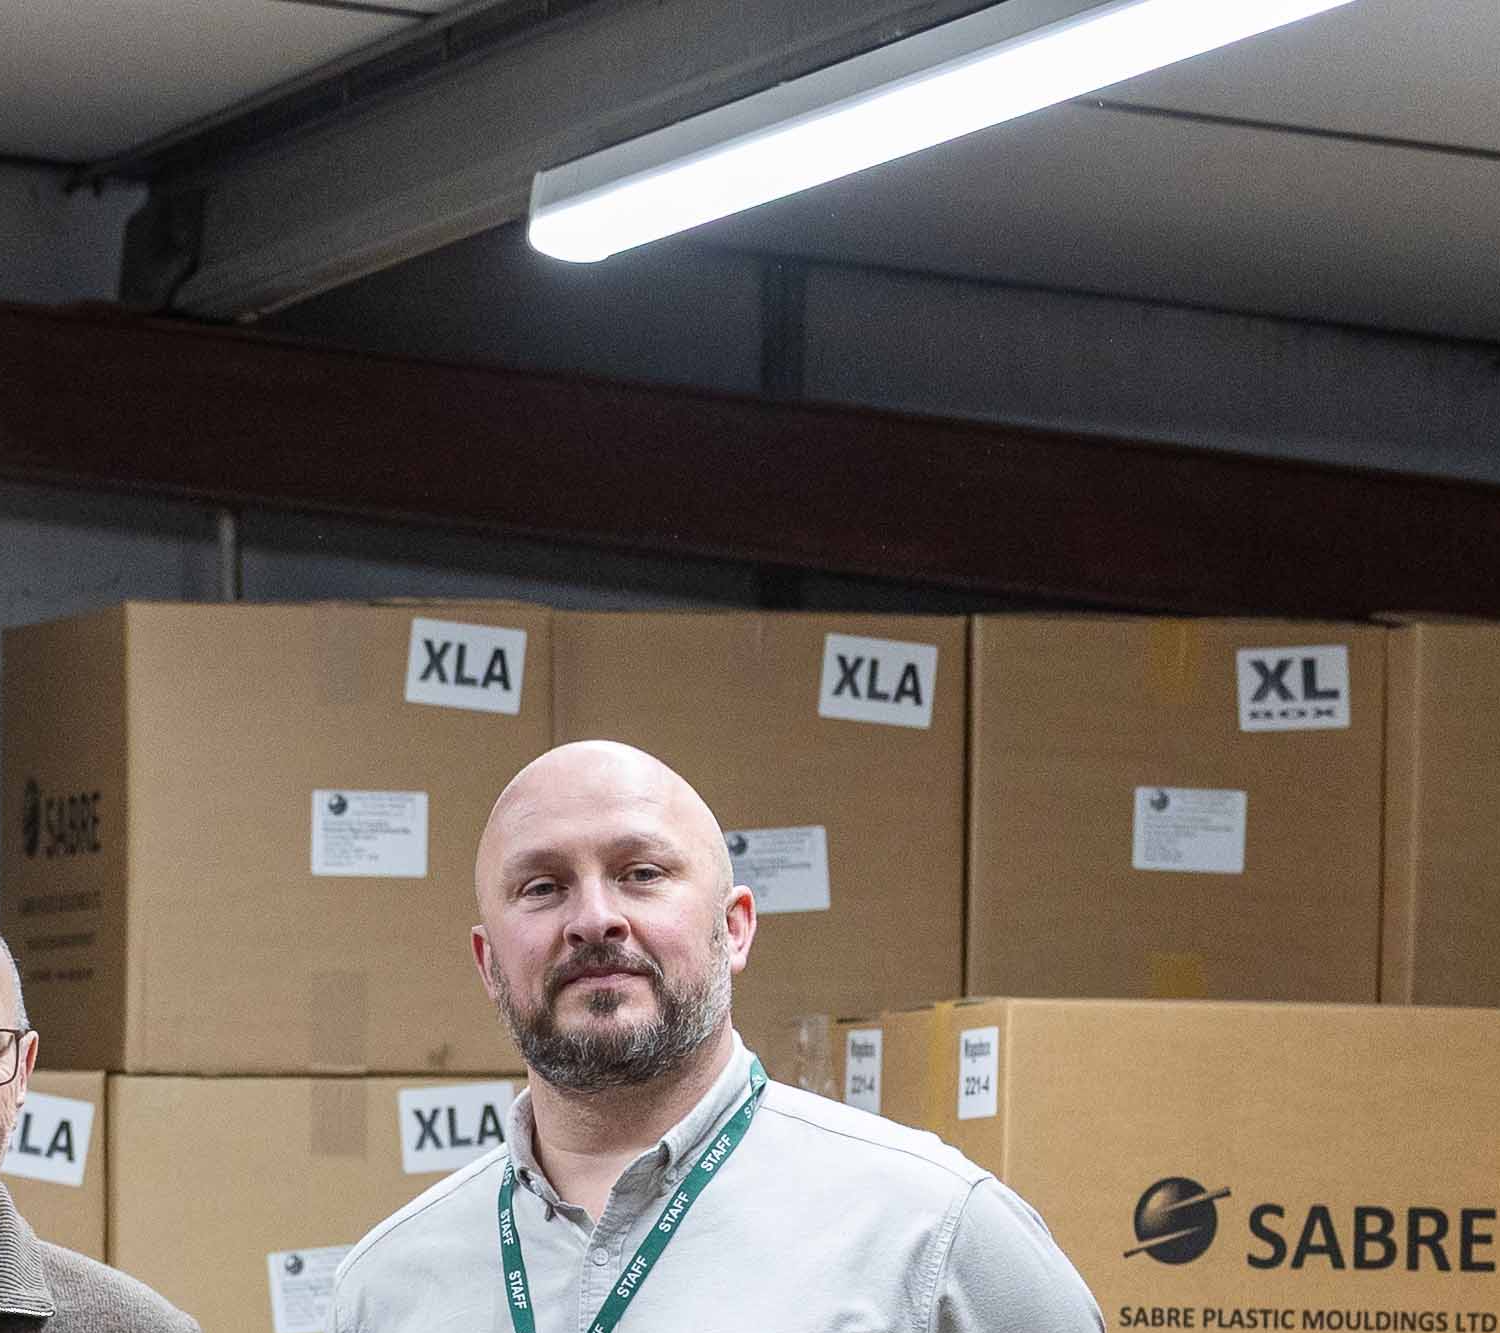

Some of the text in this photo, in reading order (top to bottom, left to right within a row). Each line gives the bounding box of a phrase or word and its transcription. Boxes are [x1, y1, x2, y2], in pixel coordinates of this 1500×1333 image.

[418, 637, 513, 692] XLA
[831, 654, 924, 707] XLA
[1249, 657, 1341, 702] XL
[10, 1111, 76, 1163] LA
[412, 1103, 505, 1152] XLA
[701, 1133, 732, 1172] STAFF
[499, 1208, 515, 1246] STAFF
[658, 1191, 690, 1233] STAFF
[1247, 1203, 1498, 1272] SABRE
[508, 1270, 528, 1310] STAFF
[616, 1255, 649, 1298] STAFF
[1119, 1305, 1498, 1333] SABRE PLASTIC MOULDINGS LTD
